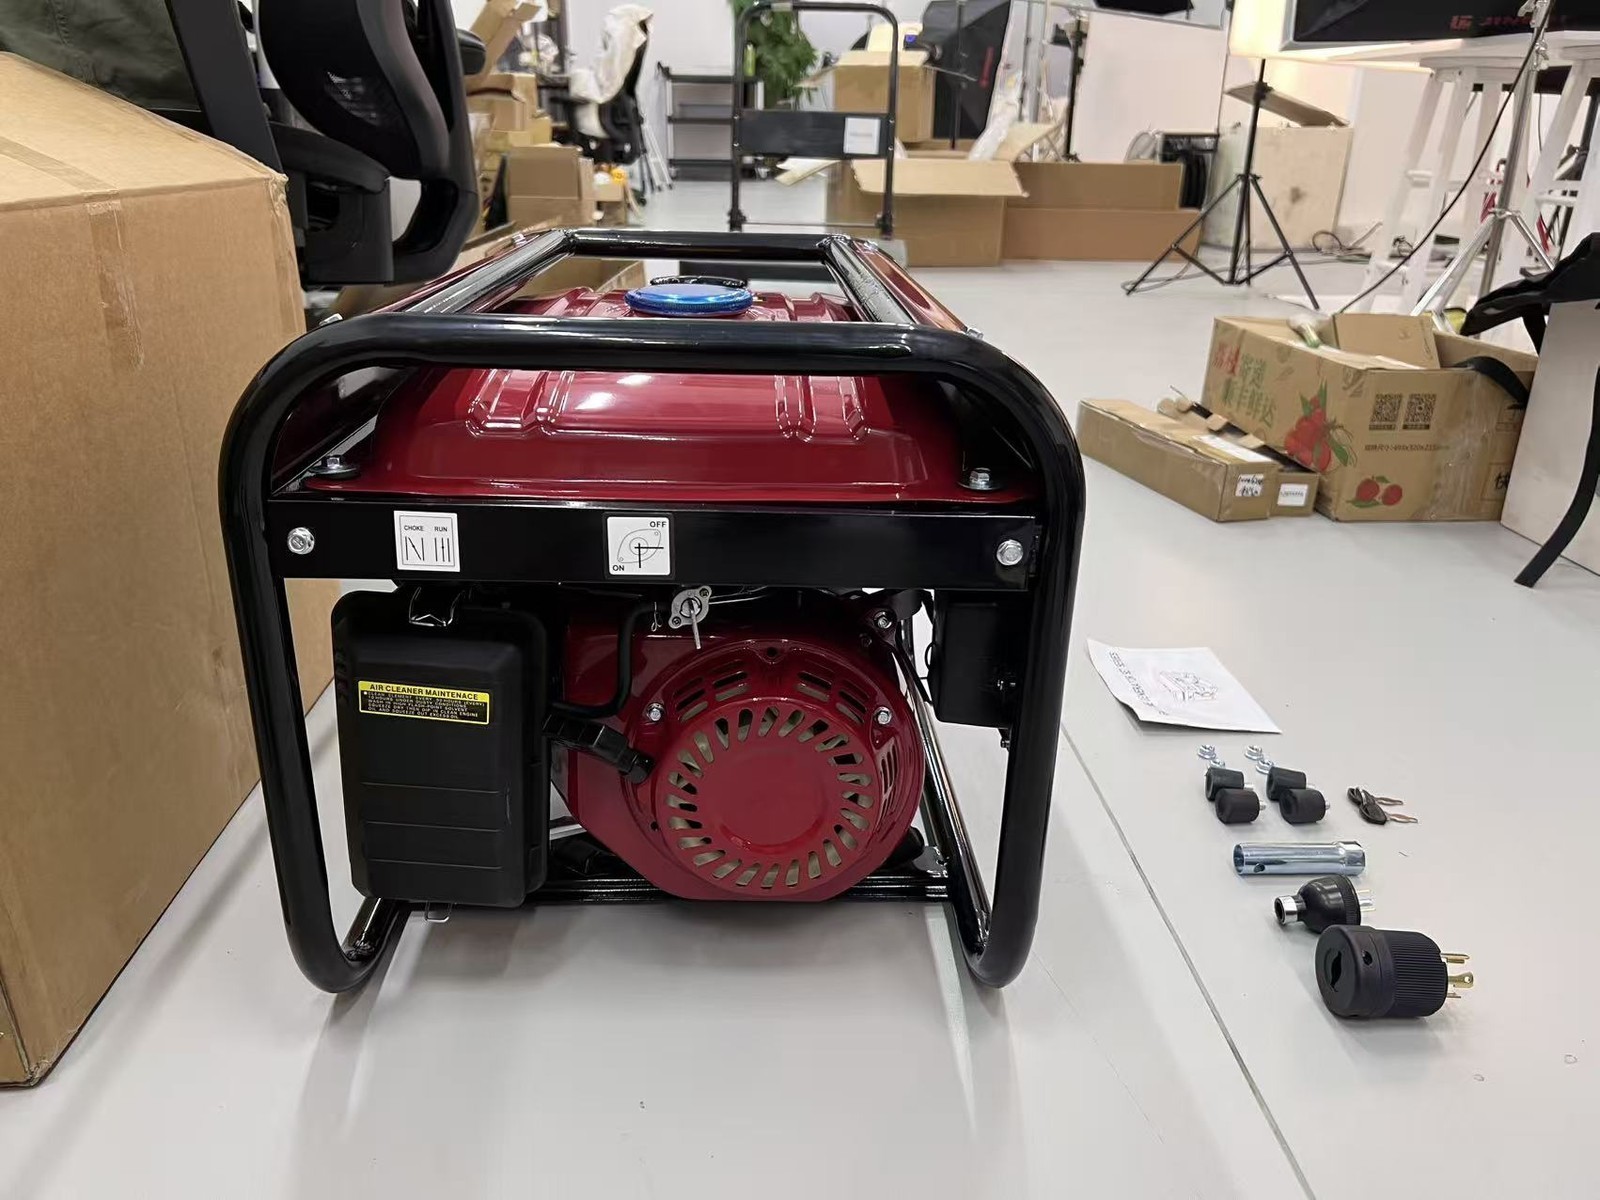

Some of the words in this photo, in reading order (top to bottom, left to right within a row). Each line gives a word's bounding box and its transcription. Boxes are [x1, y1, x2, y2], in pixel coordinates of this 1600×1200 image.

[649, 520, 667, 528] OFF
[612, 564, 625, 572] ON
[386, 686, 423, 694] CLEANER
[425, 690, 478, 700] MAINTENACE
